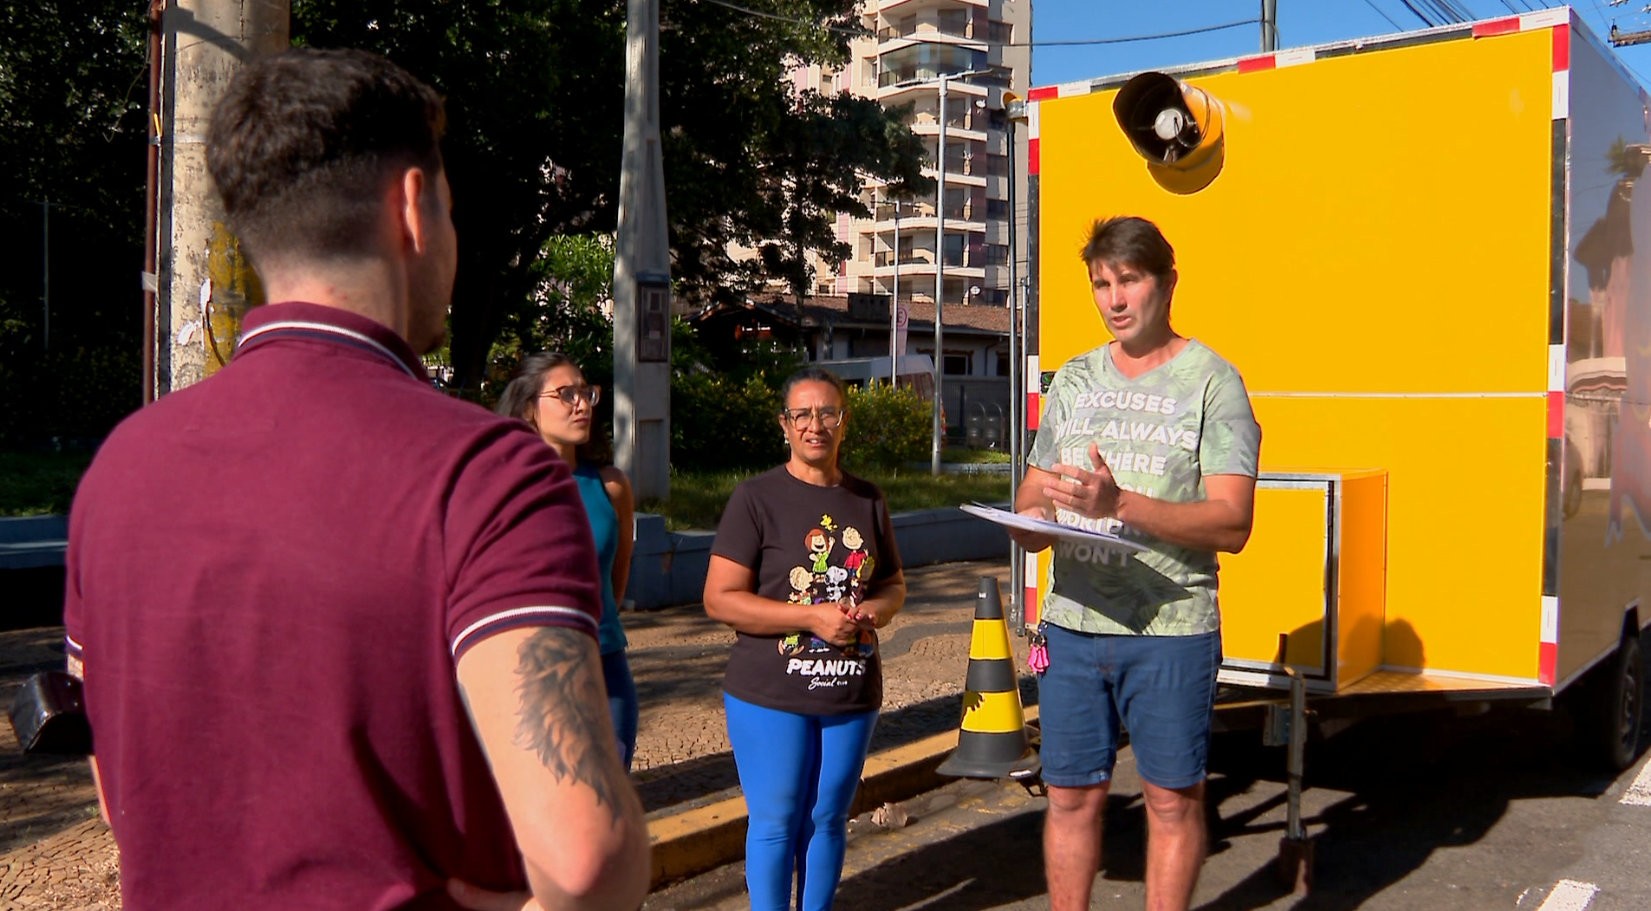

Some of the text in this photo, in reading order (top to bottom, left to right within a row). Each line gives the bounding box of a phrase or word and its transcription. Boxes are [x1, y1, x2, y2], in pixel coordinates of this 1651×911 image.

[1074, 391, 1177, 415] EXCUSES
[1101, 420, 1198, 452] ALWAYS
[1060, 541, 1130, 567] WON'T
[786, 658, 867, 676] PEANUTS
[808, 676, 838, 691] Social
